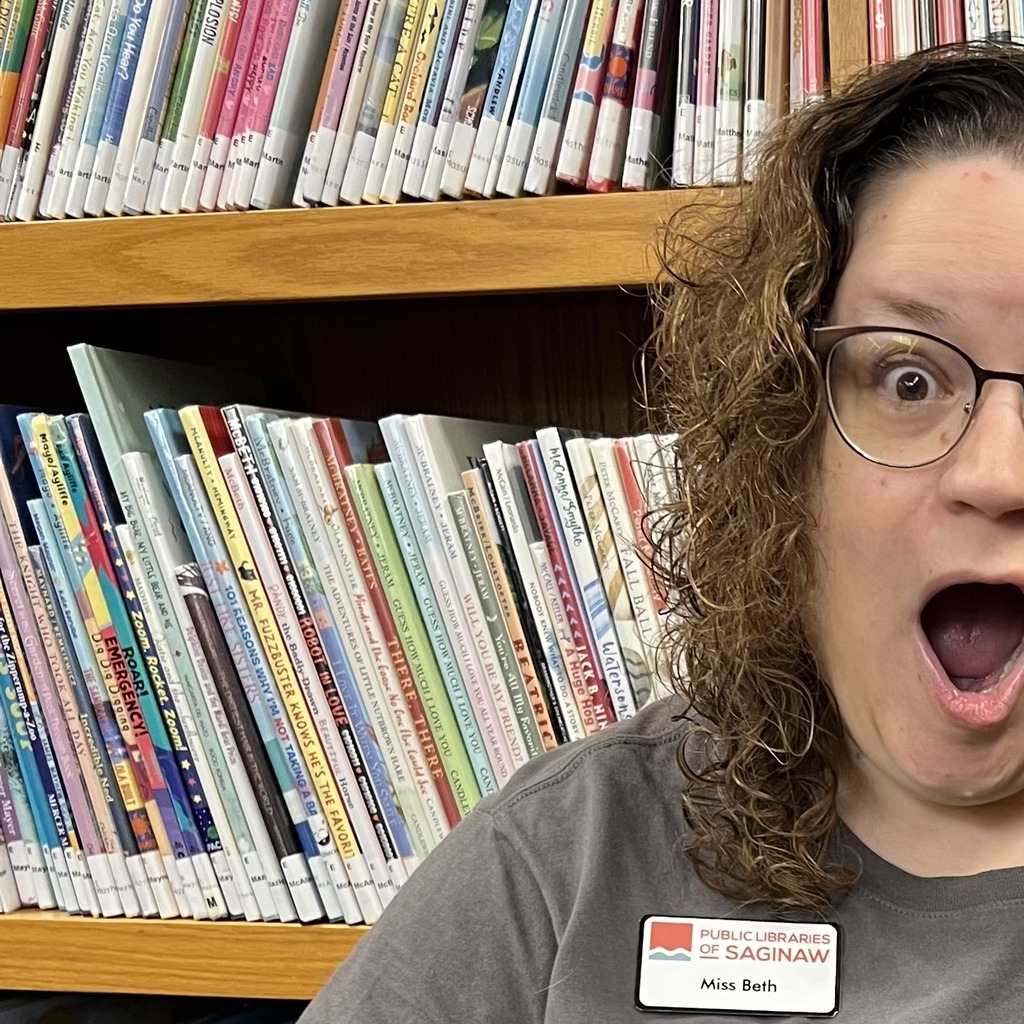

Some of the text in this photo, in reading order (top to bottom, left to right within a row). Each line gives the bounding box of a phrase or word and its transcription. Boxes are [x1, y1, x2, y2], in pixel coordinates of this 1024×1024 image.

[105, 636, 149, 737] EMERGENCY!
[123, 647, 149, 697] ROAR!
[225, 586, 311, 799] 101 REASONS WHY I'M NOT TAKING A
[394, 599, 409, 632] GUESS
[406, 636, 420, 662] HOW
[413, 665, 430, 696] MUCH
[429, 706, 443, 731] LOVE
[439, 734, 452, 757] YOU
[249, 591, 263, 614] MR.
[260, 619, 296, 698] FUZZBUSTER
[290, 702, 314, 746] KNOWS
[309, 751, 325, 778] HE'S
[319, 783, 334, 806] THE
[164, 709, 188, 751] Zoom!
[700, 944, 829, 963] OF SAGINAW
[701, 929, 830, 944] PUBLIC LIBRARIES
[701, 978, 777, 992] Miss Beth
